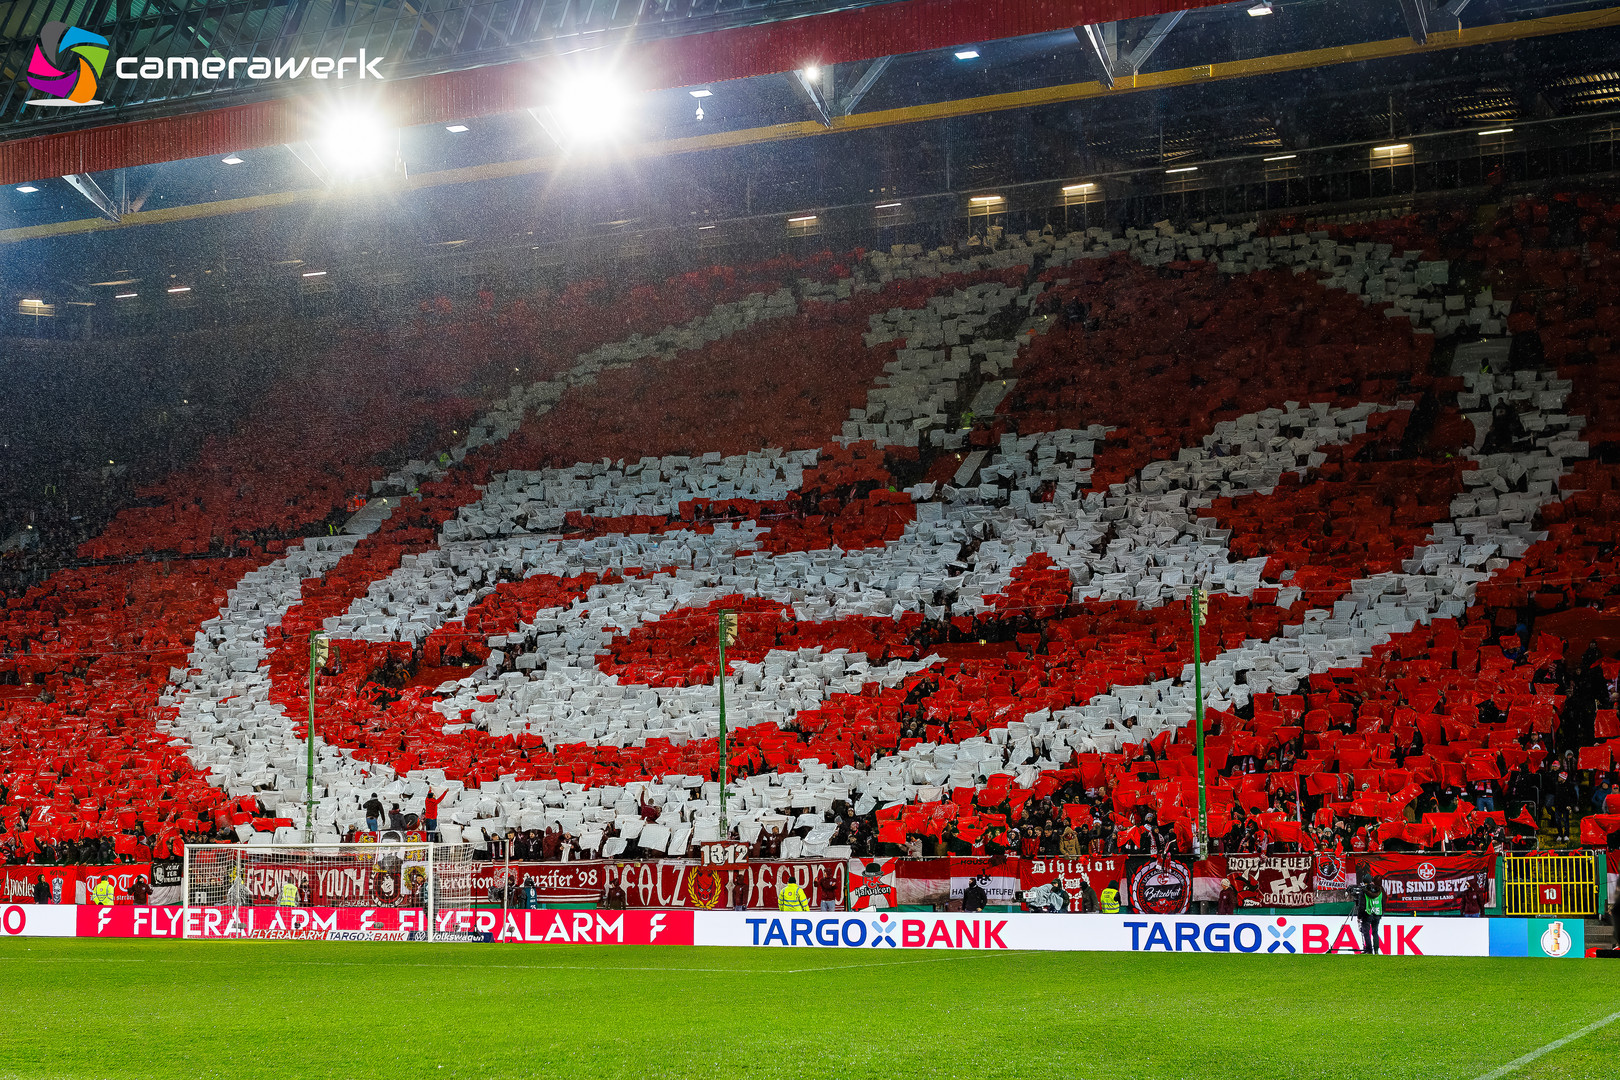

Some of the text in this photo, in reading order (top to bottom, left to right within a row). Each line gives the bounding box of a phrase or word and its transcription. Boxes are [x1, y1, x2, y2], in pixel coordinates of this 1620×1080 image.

[701, 844, 749, 866] 1312
[4, 870, 35, 902] Apostles
[317, 868, 366, 897] YOUTH
[576, 868, 599, 887] '98
[603, 864, 687, 907] PFALZ
[1382, 875, 1475, 895] WIR SIND BETZ
[855, 886, 892, 897] Halunken
[1544, 888, 1557, 900] 10
[134, 908, 338, 937] FLYERALARM
[400, 910, 624, 943] FLYERALARM
[251, 929, 326, 940] FLYERALARM
